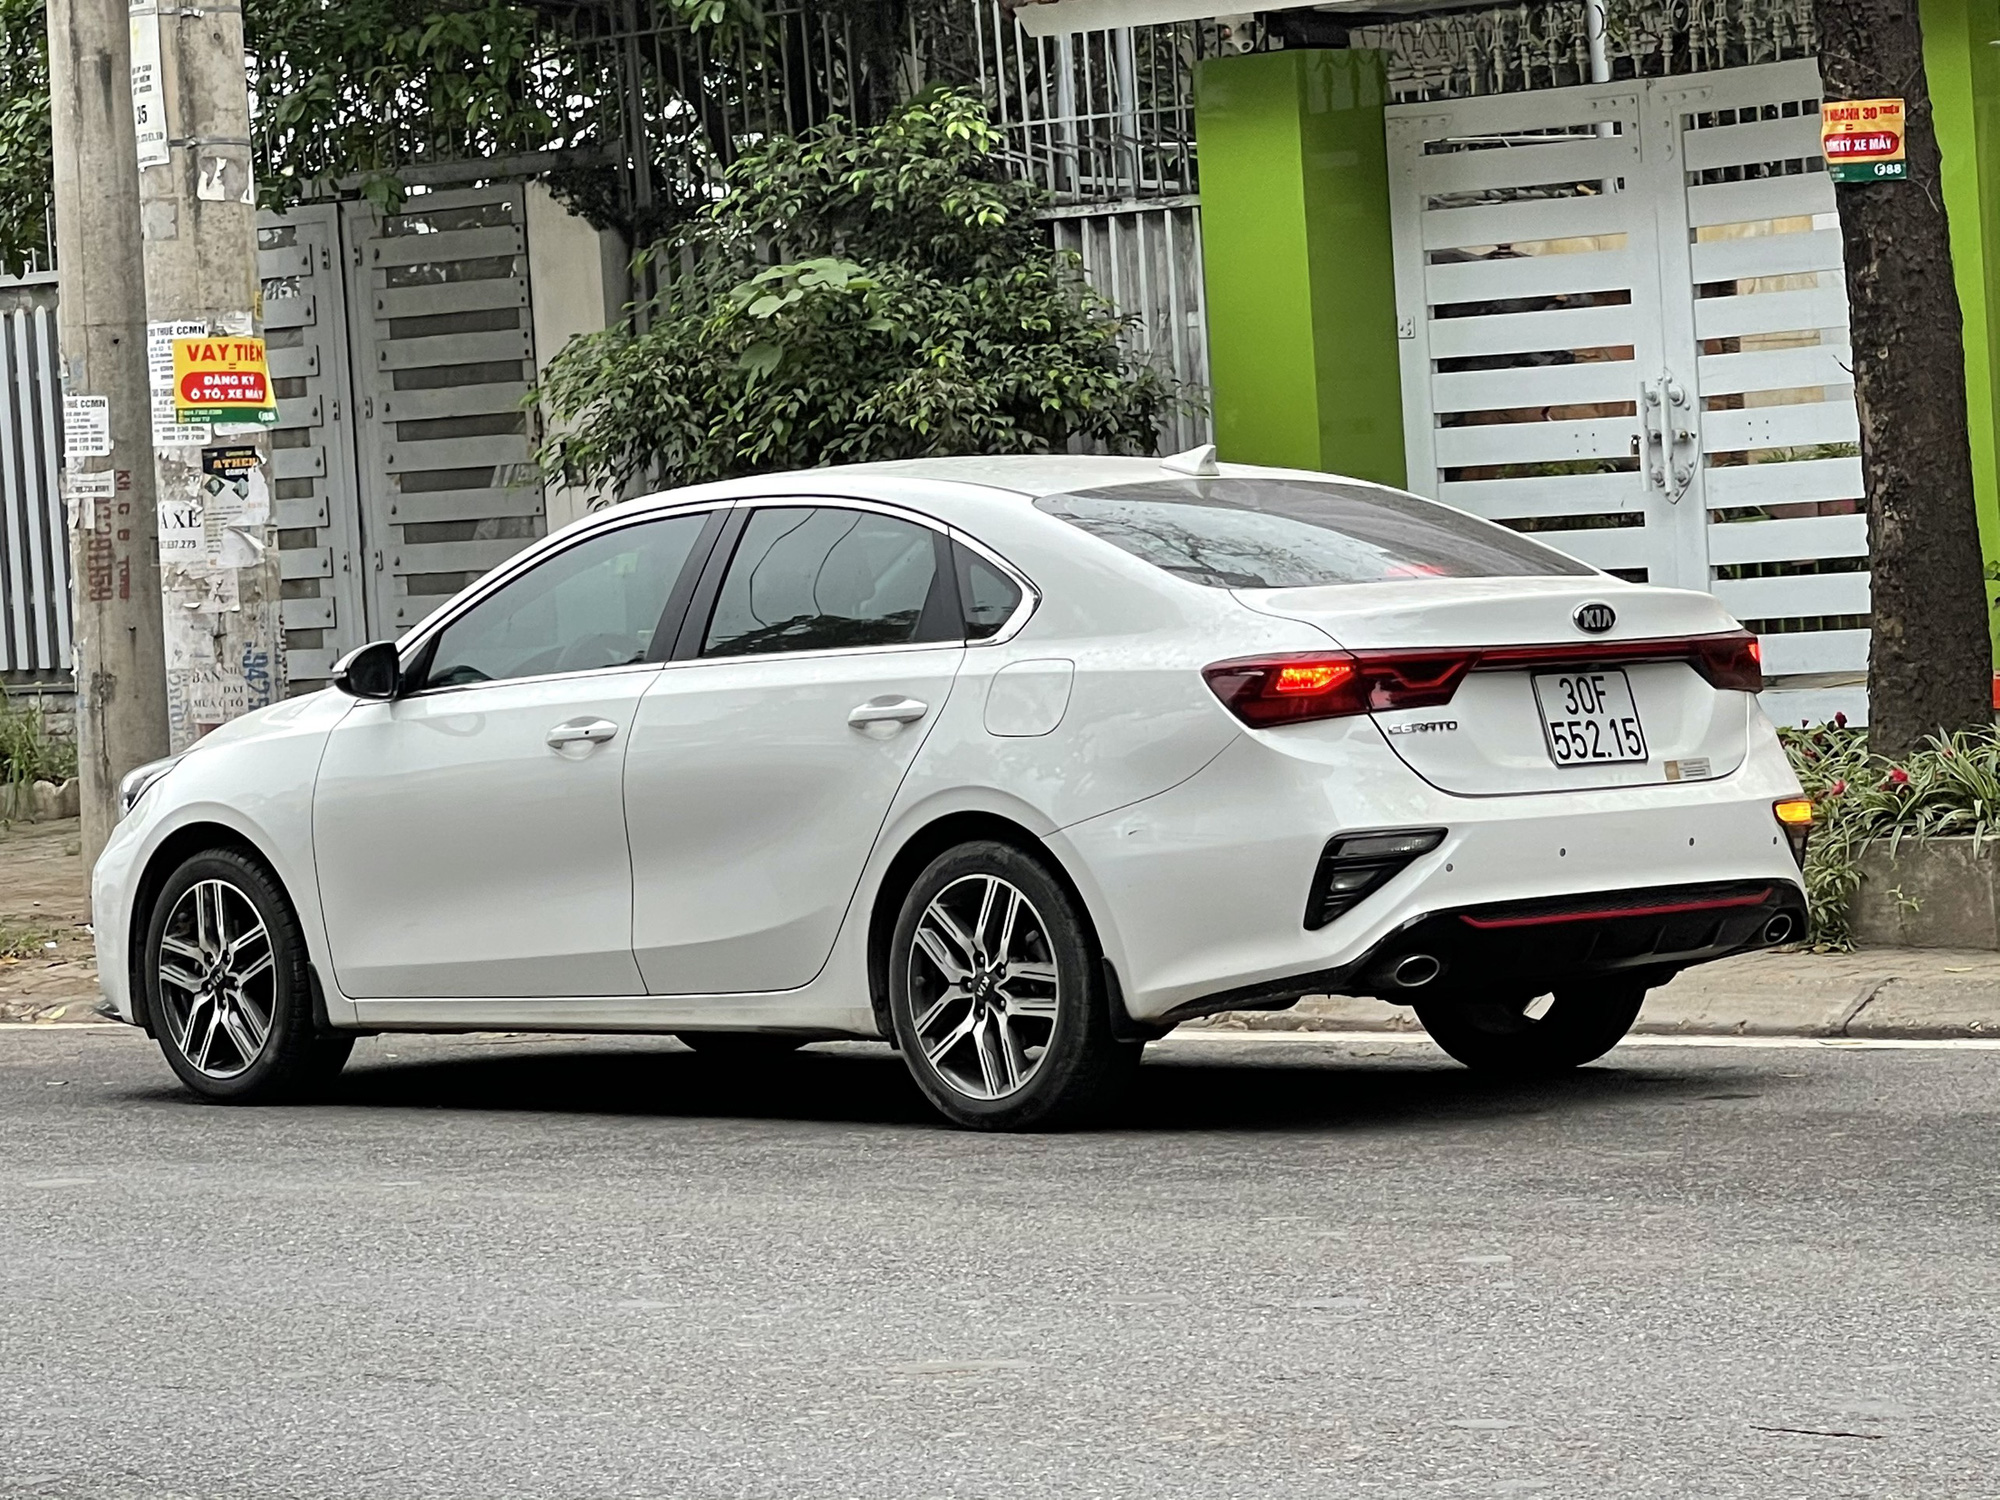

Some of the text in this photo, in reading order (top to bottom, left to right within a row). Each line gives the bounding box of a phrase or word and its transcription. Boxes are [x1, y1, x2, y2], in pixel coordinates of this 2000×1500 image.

[1862, 107, 1878, 120] 30
[1854, 138, 1867, 151] XE
[1869, 135, 1892, 150] MÁY
[1874, 164, 1902, 176] F88
[176, 325, 205, 334] CCMN
[186, 344, 230, 362] VAY
[241, 374, 255, 386] KÝ
[191, 388, 200, 399] Ô
[228, 388, 243, 399] XE
[80, 400, 106, 408] CCMN
[172, 510, 202, 529] XE
[1582, 608, 1612, 628] KIA
[1558, 676, 1606, 715] 30F
[1388, 720, 1458, 735] CERATO
[1550, 718, 1642, 761] 552.15
